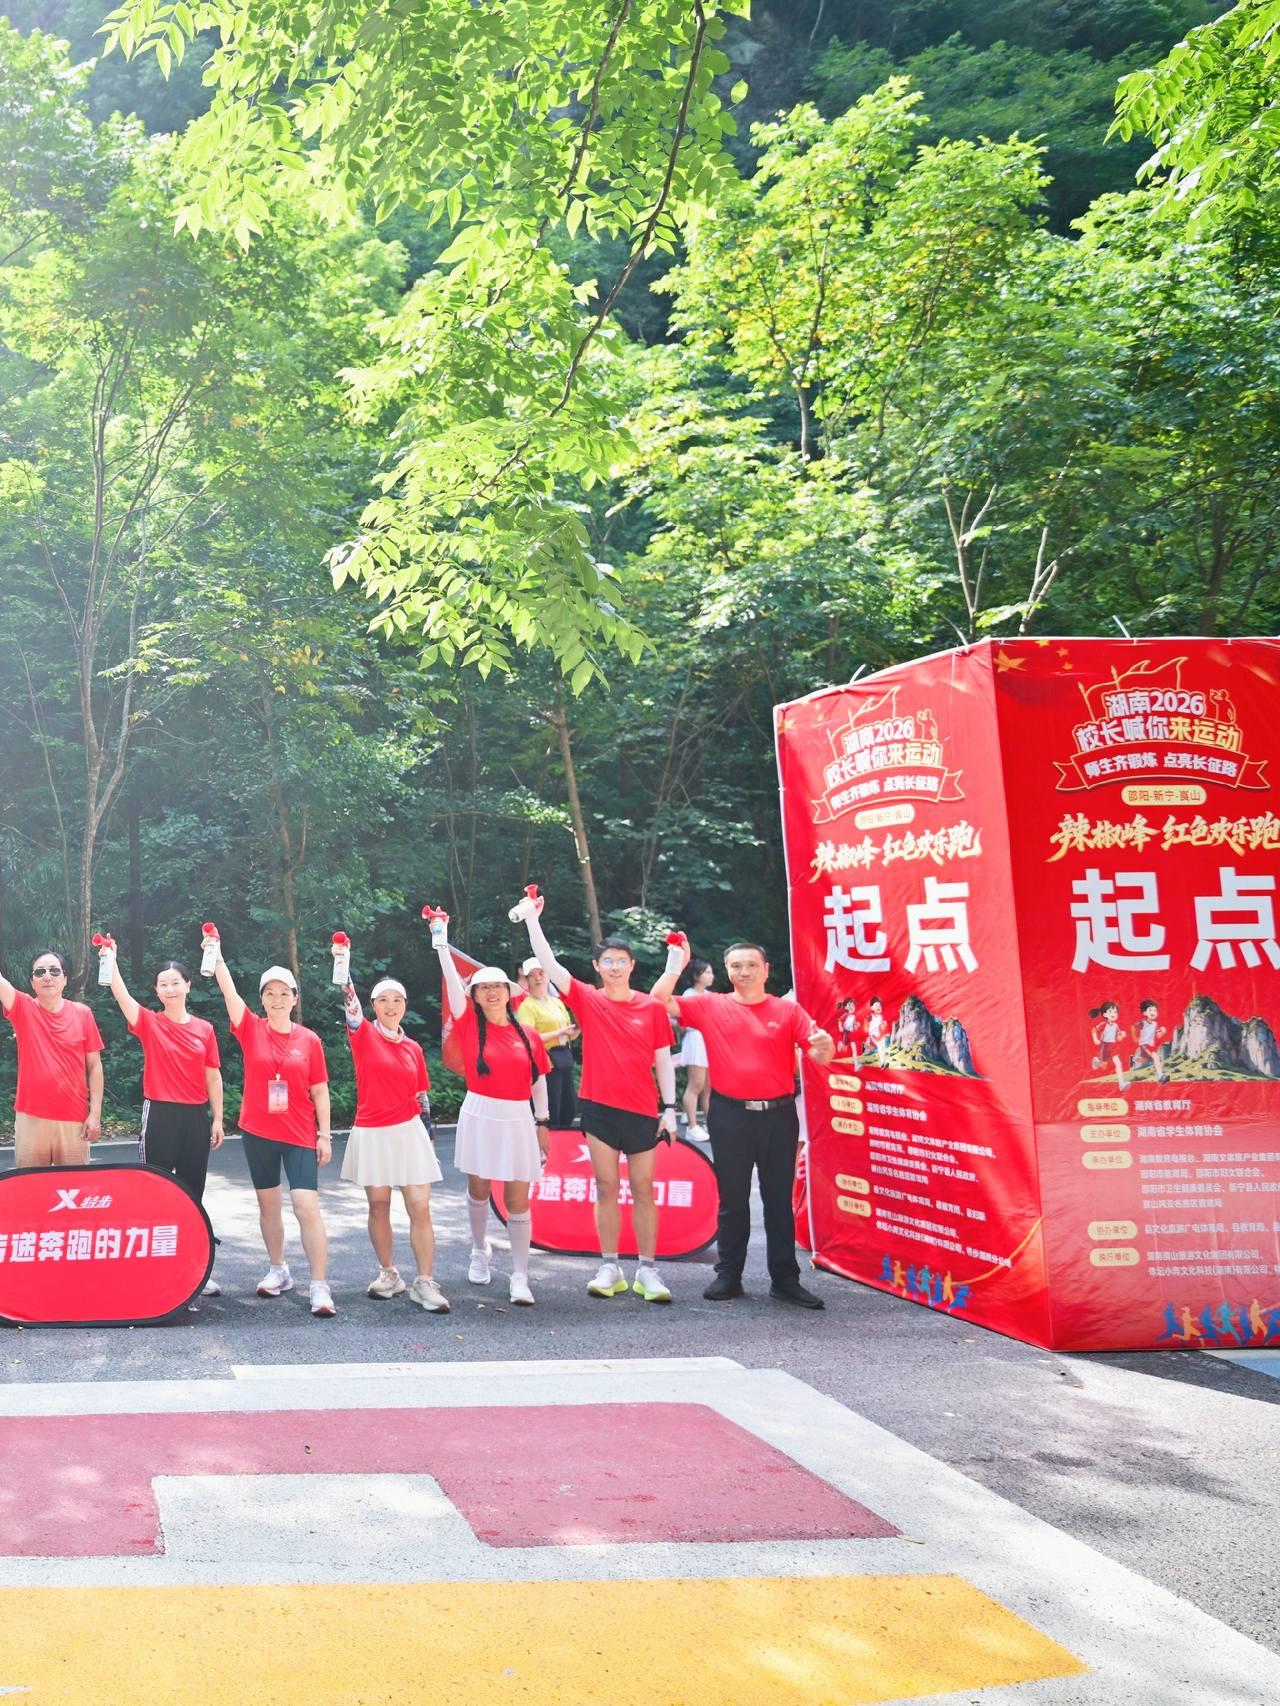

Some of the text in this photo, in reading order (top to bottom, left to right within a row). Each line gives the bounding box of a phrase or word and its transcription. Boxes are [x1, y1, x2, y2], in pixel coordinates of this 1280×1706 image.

[1105, 690, 1205, 719] 湖南2026
[844, 719, 914, 754] 湖南2026
[1075, 716, 1241, 754] 校长喊你来运动
[1084, 752, 1238, 779] 师生齐锻炼 点亮长征路
[1044, 812, 1161, 863] 辣椒峰
[824, 876, 980, 975] 起点
[1070, 867, 1280, 974] 起点
[78, 1195, 113, 1209] 特步
